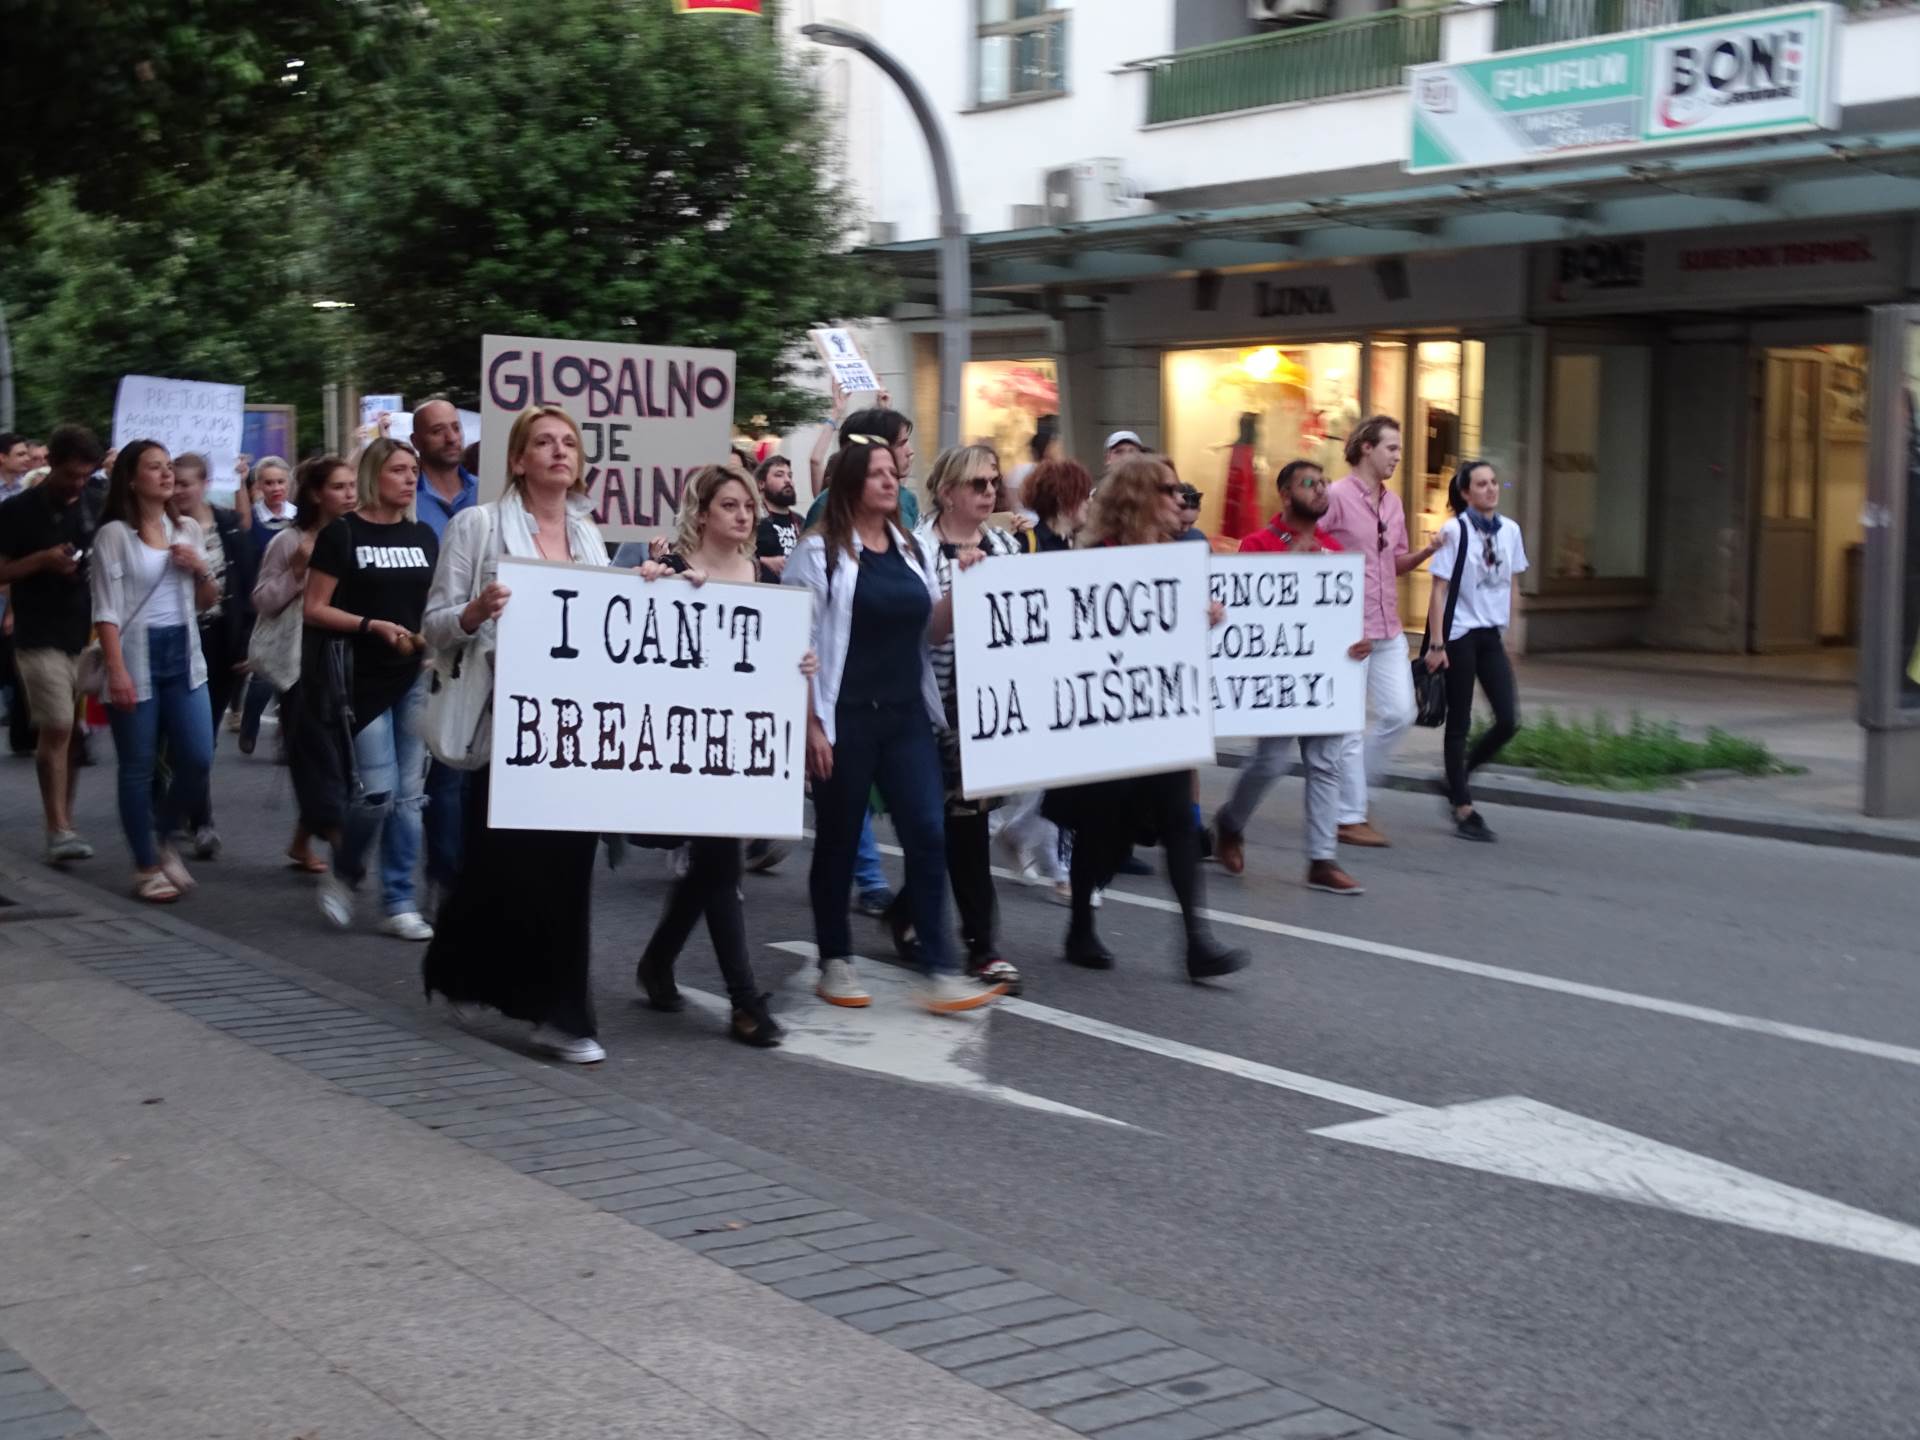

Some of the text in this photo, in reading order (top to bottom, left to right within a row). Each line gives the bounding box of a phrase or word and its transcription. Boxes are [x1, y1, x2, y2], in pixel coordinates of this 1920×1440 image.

[1491, 53, 1628, 100] FUJIFILM
[488, 350, 730, 418] GLOBALNO
[581, 422, 632, 464] JE
[356, 545, 430, 570] PUMA
[1314, 570, 1355, 606] IS
[550, 589, 761, 673] I CAN'T
[985, 577, 1182, 649] NE MOGU
[971, 651, 1201, 741] DA DIŠEM!
[505, 695, 792, 780] BREATHE!
